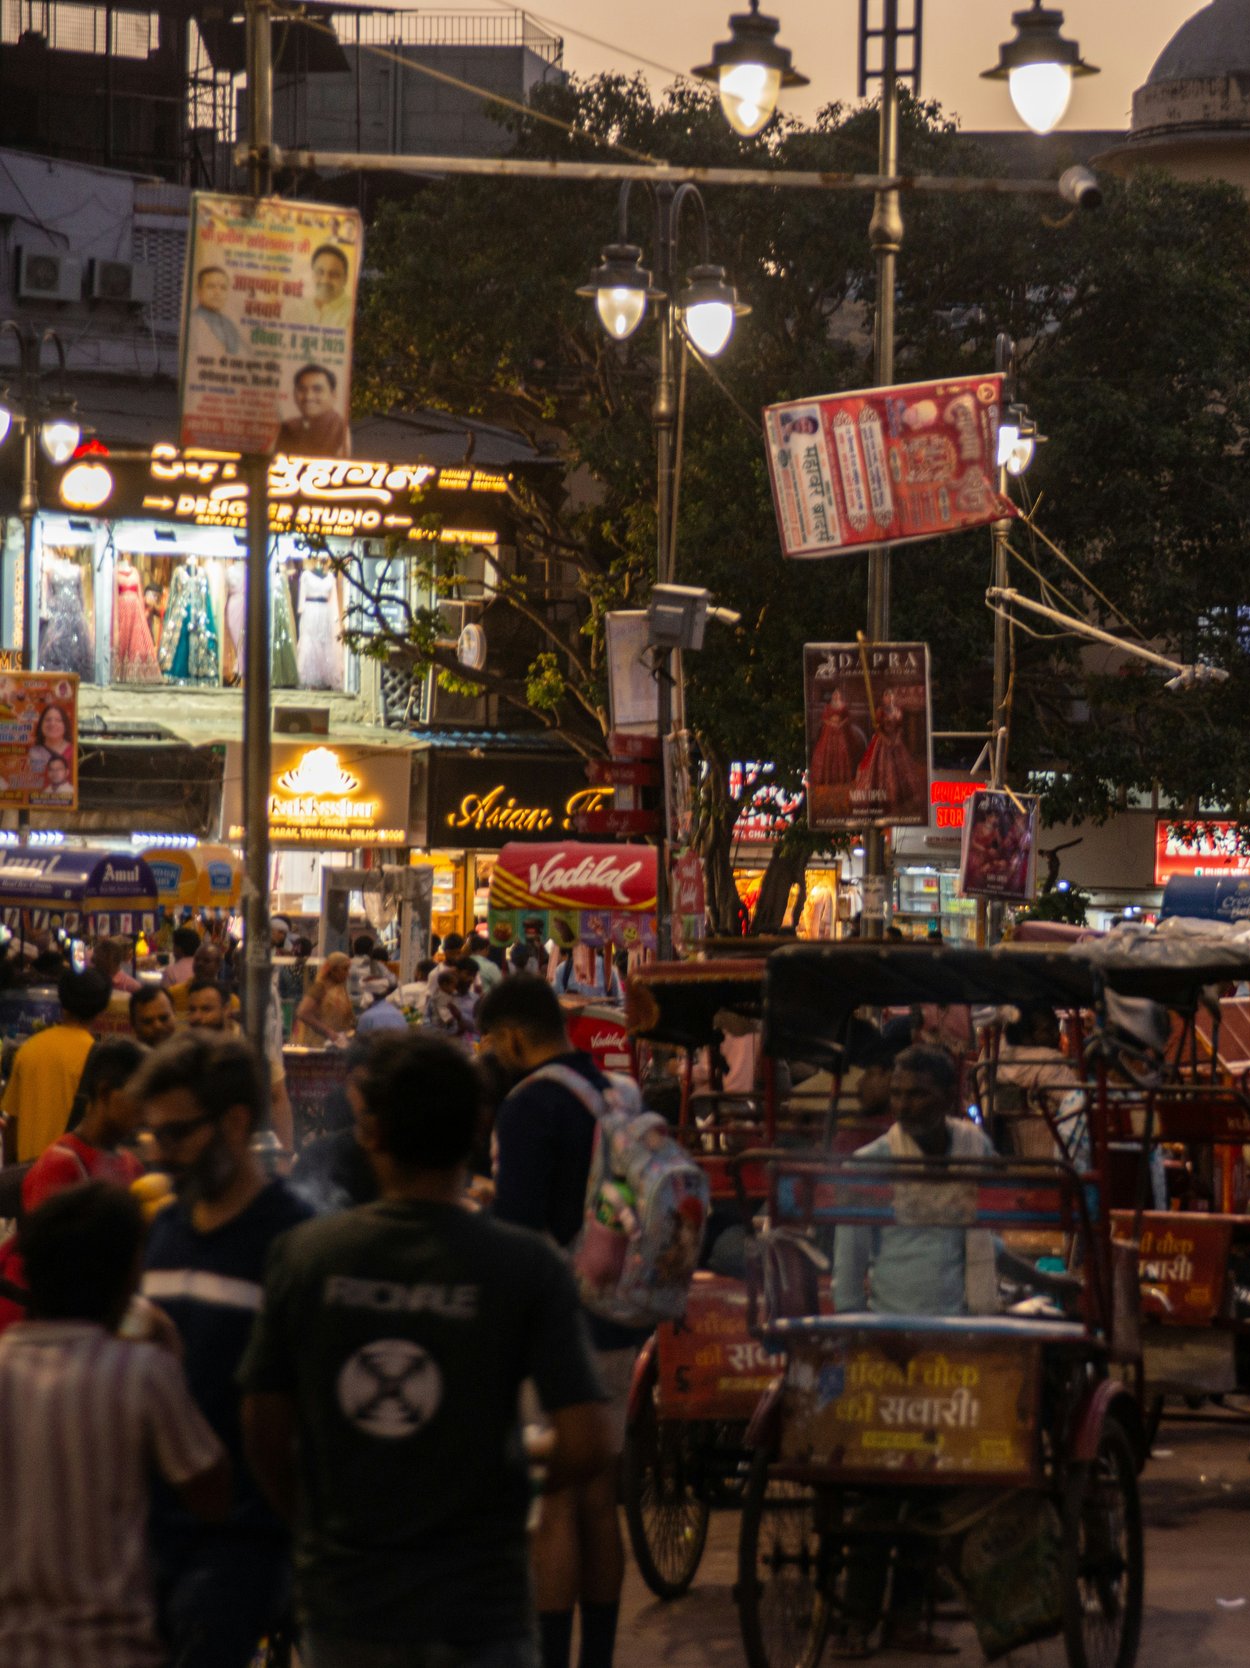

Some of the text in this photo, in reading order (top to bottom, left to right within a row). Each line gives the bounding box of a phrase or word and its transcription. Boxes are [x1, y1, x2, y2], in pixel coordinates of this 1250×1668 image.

[295, 505, 381, 530] STUDIO
[448, 785, 552, 831] Asian
[103, 863, 140, 883] Amul
[529, 853, 643, 904] Vadilal
[878, 1387, 980, 1428] सवारी!
